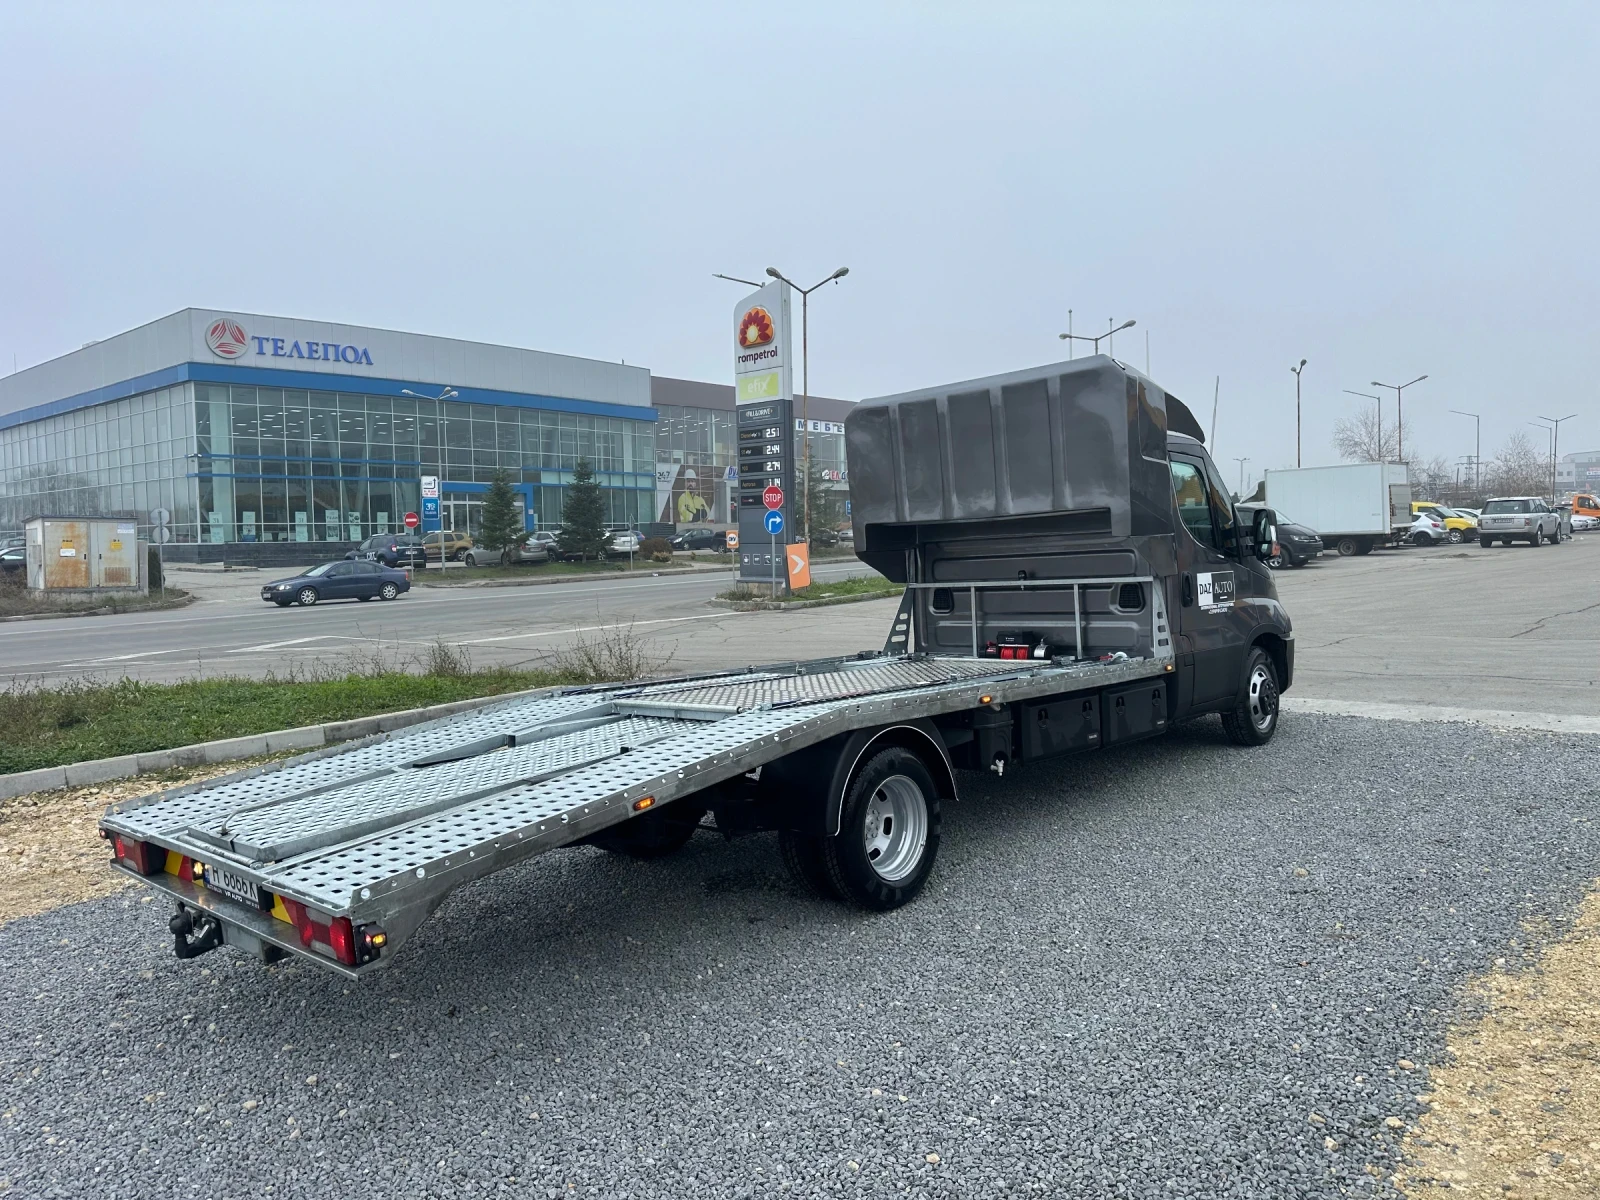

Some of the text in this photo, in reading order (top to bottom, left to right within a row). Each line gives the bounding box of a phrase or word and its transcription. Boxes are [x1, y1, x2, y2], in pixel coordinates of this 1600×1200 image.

[251, 335, 374, 366] ТЕЛЕПОЛ
[737, 346, 778, 364] rompetrol
[766, 444, 780, 455] 2.44
[765, 493, 782, 502] STOP
[1199, 580, 1233, 594] DAZ AUTO
[231, 893, 243, 902] AUTO
